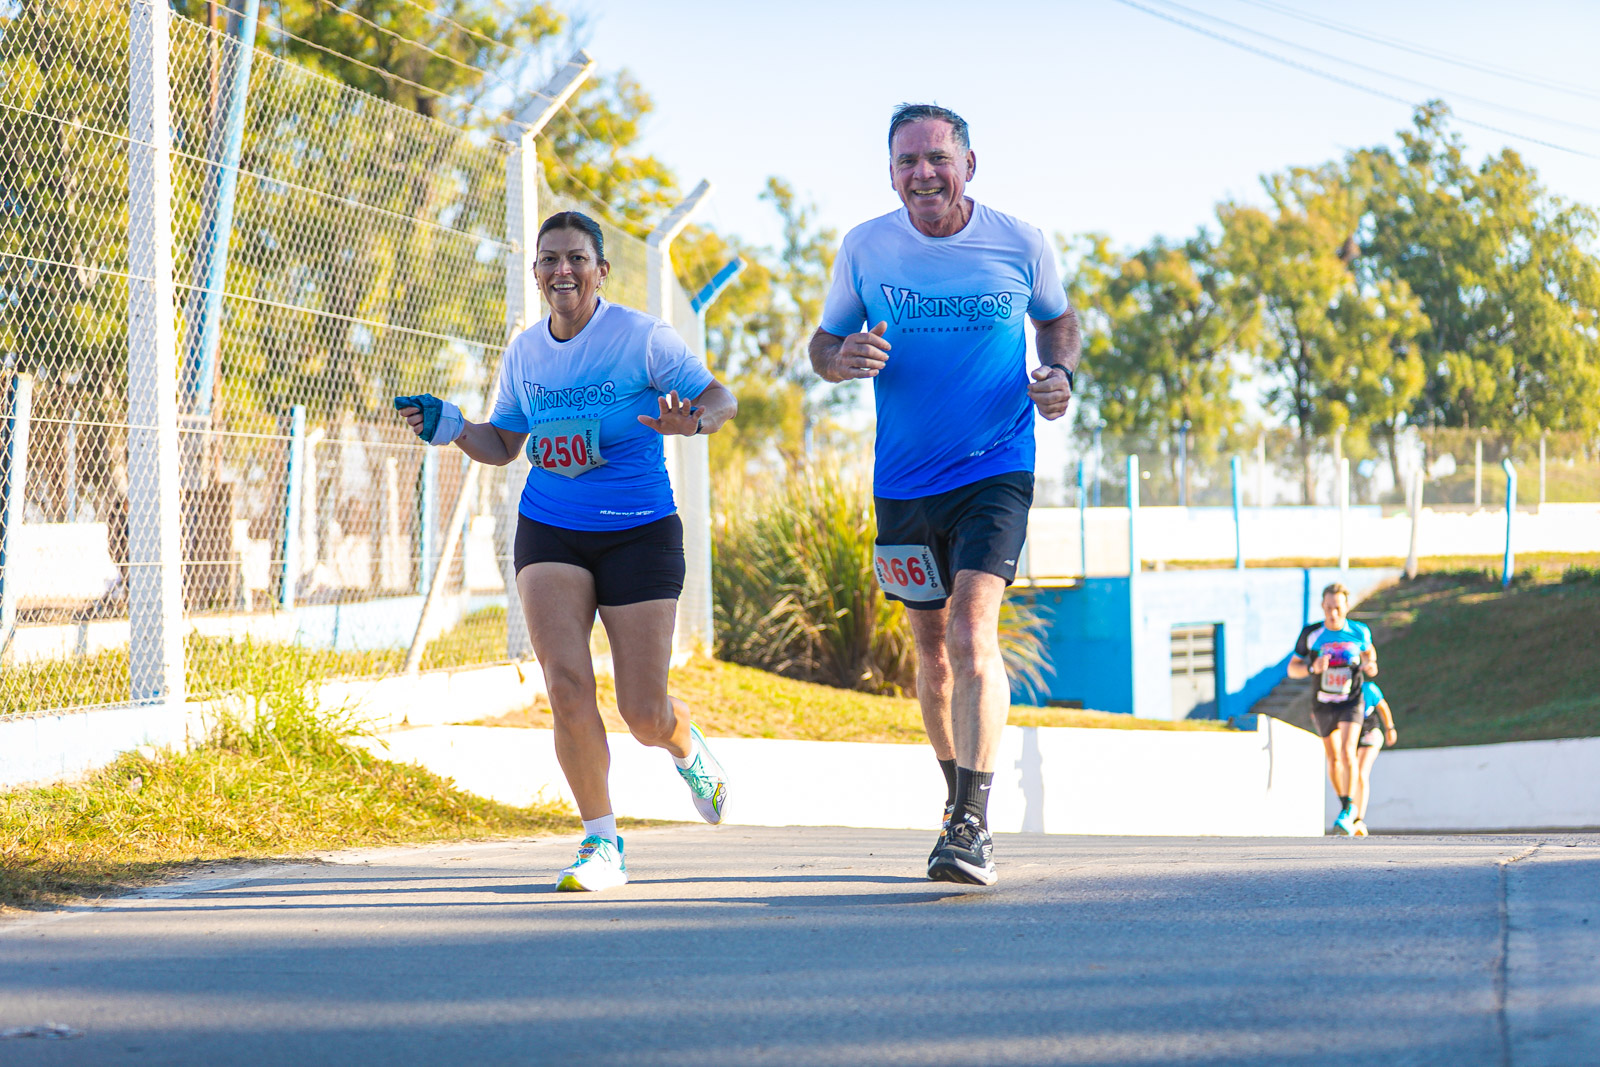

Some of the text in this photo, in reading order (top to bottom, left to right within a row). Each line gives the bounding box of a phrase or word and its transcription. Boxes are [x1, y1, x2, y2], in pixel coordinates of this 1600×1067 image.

[902, 325, 994, 334] ENTRENAMIENTO
[539, 434, 588, 468] 250
[585, 429, 598, 466] EXACTO
[876, 556, 926, 587] 366
[921, 553, 939, 589] EXACTO
